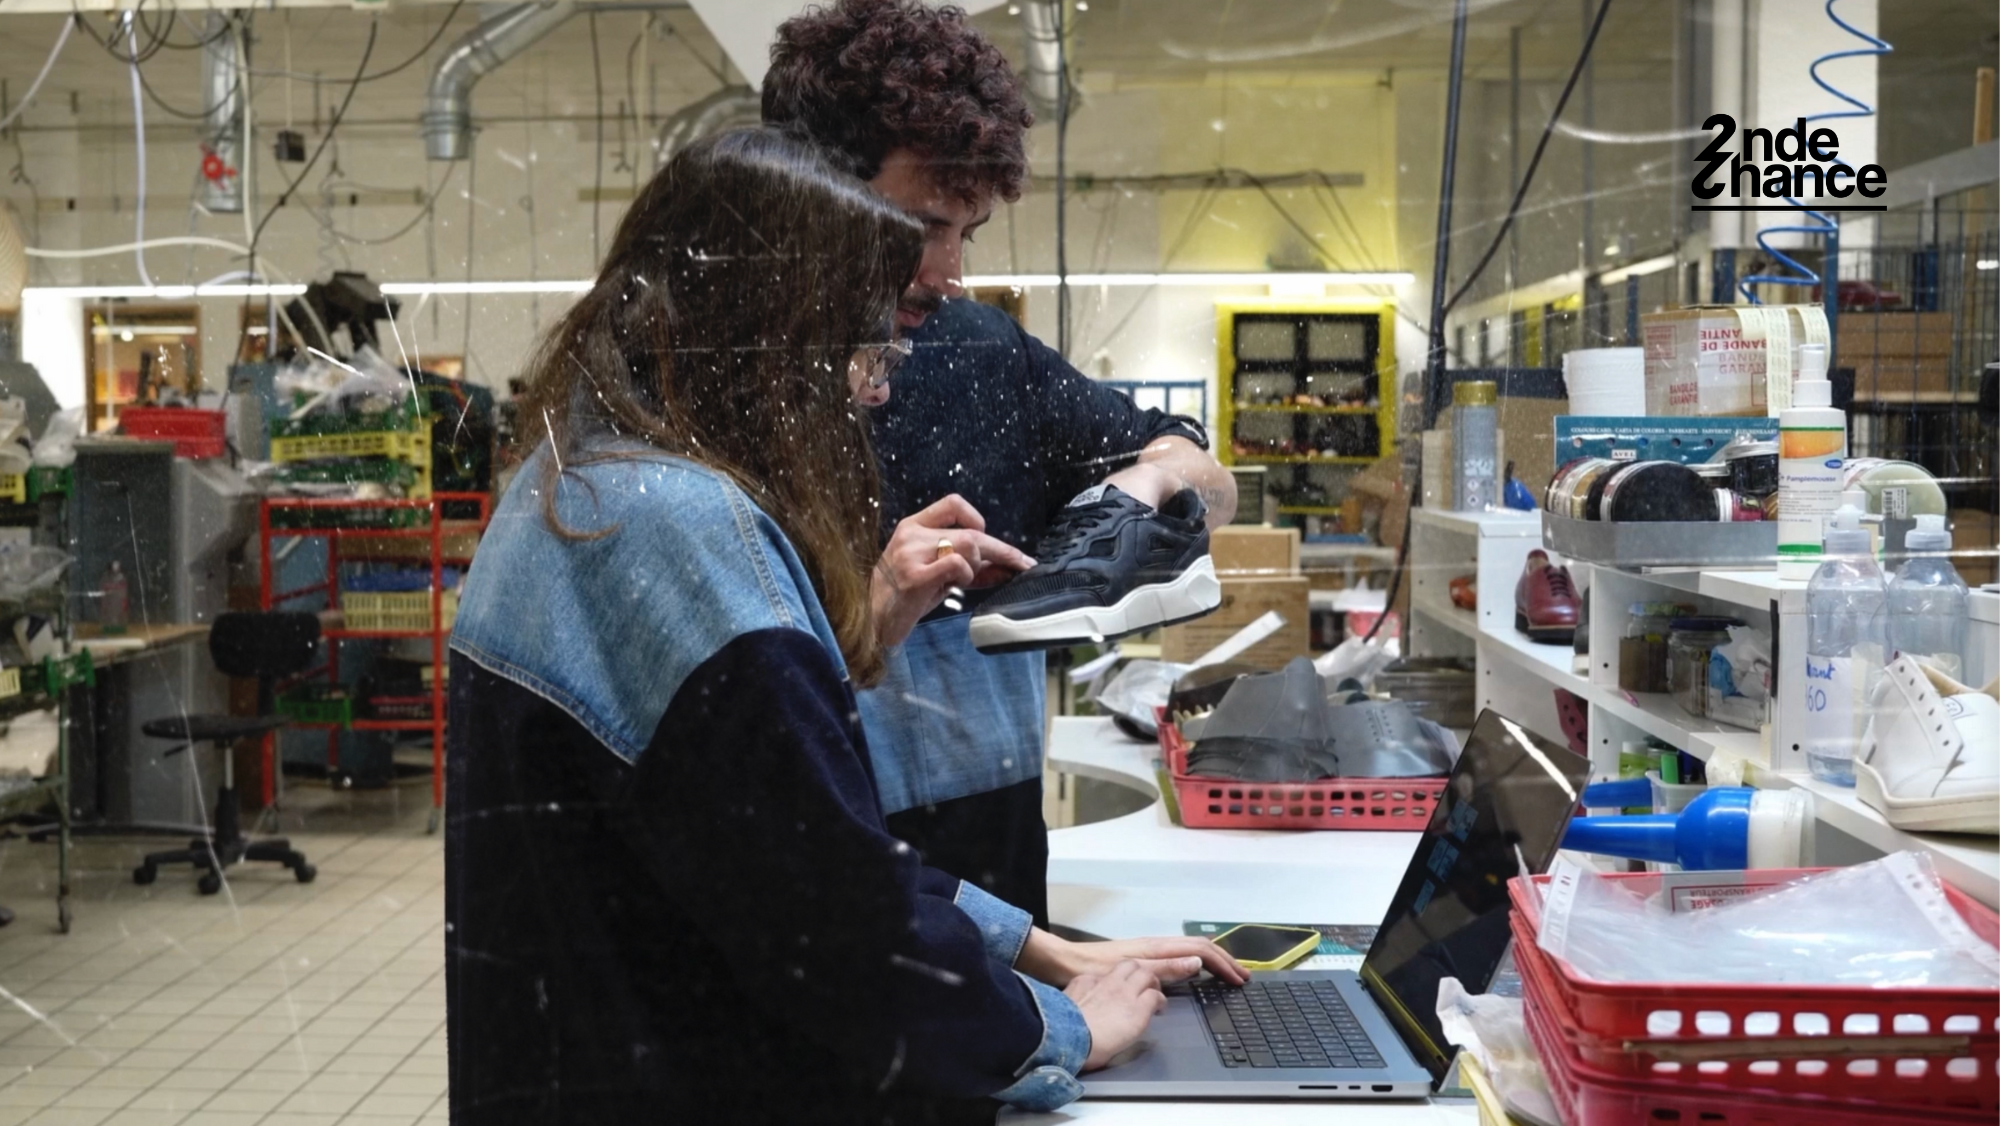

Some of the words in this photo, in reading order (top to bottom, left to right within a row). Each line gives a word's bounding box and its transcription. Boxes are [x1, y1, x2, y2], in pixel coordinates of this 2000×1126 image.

[1700, 329, 1741, 339] ANTIE
[1700, 341, 1718, 351] DE
[1719, 363, 1767, 374] GARAN
[1786, 475, 1837, 483] Pamplemousse
[1807, 685, 1827, 712] 60
